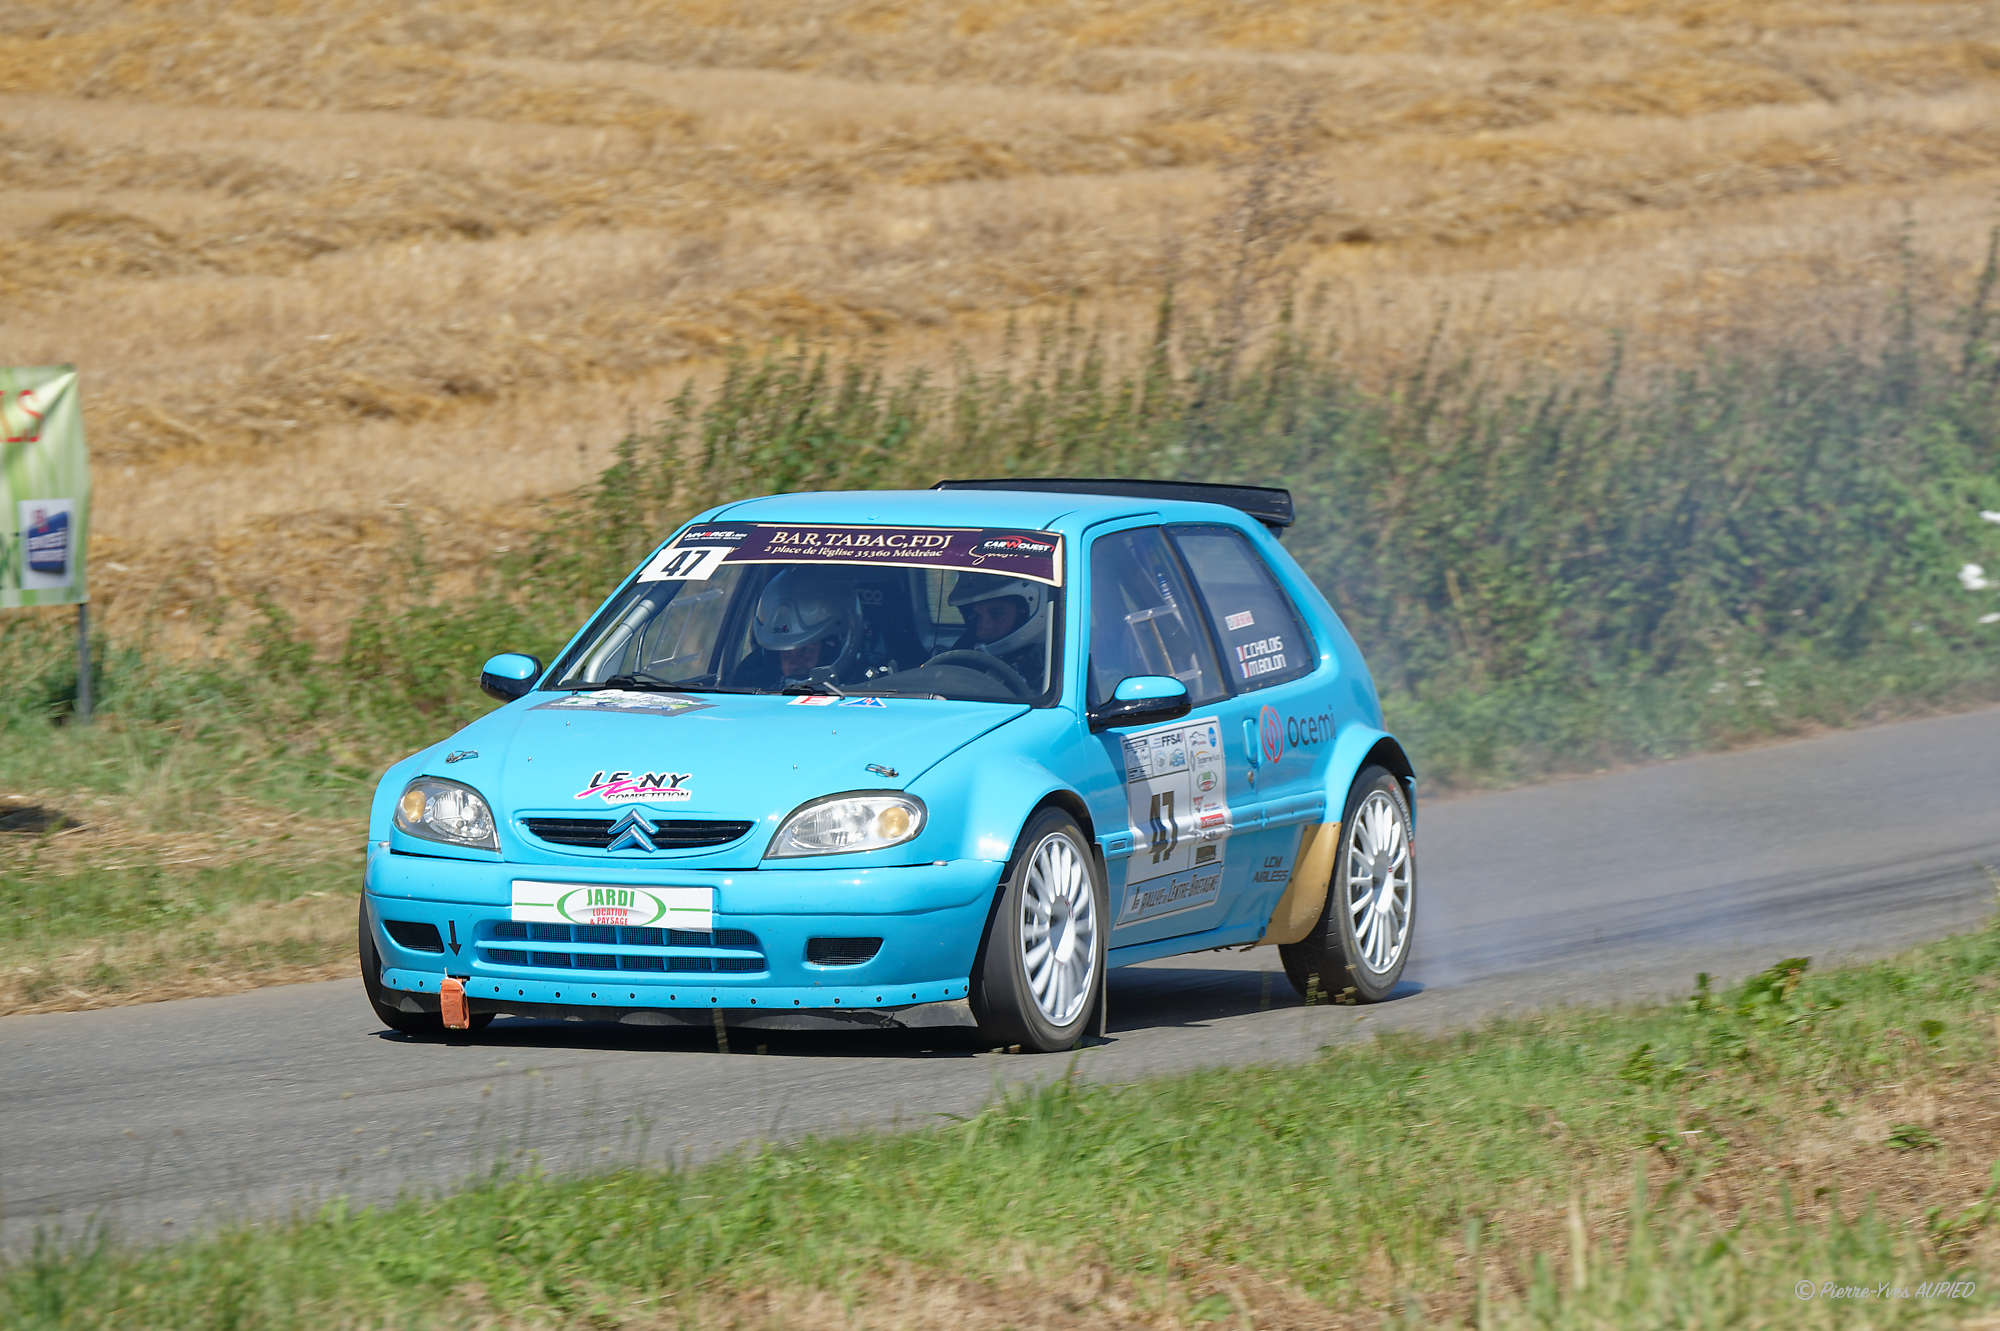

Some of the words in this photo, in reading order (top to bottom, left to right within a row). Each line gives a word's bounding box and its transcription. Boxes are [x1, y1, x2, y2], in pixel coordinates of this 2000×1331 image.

[771, 546, 801, 554] place
[802, 547, 817, 555] de
[855, 550, 891, 558] 35360
[661, 550, 711, 576] 47
[1149, 791, 1178, 864] 47
[586, 888, 635, 907] JARDI
[592, 908, 628, 917] LOCATION
[597, 917, 628, 926] PAYSAGE
